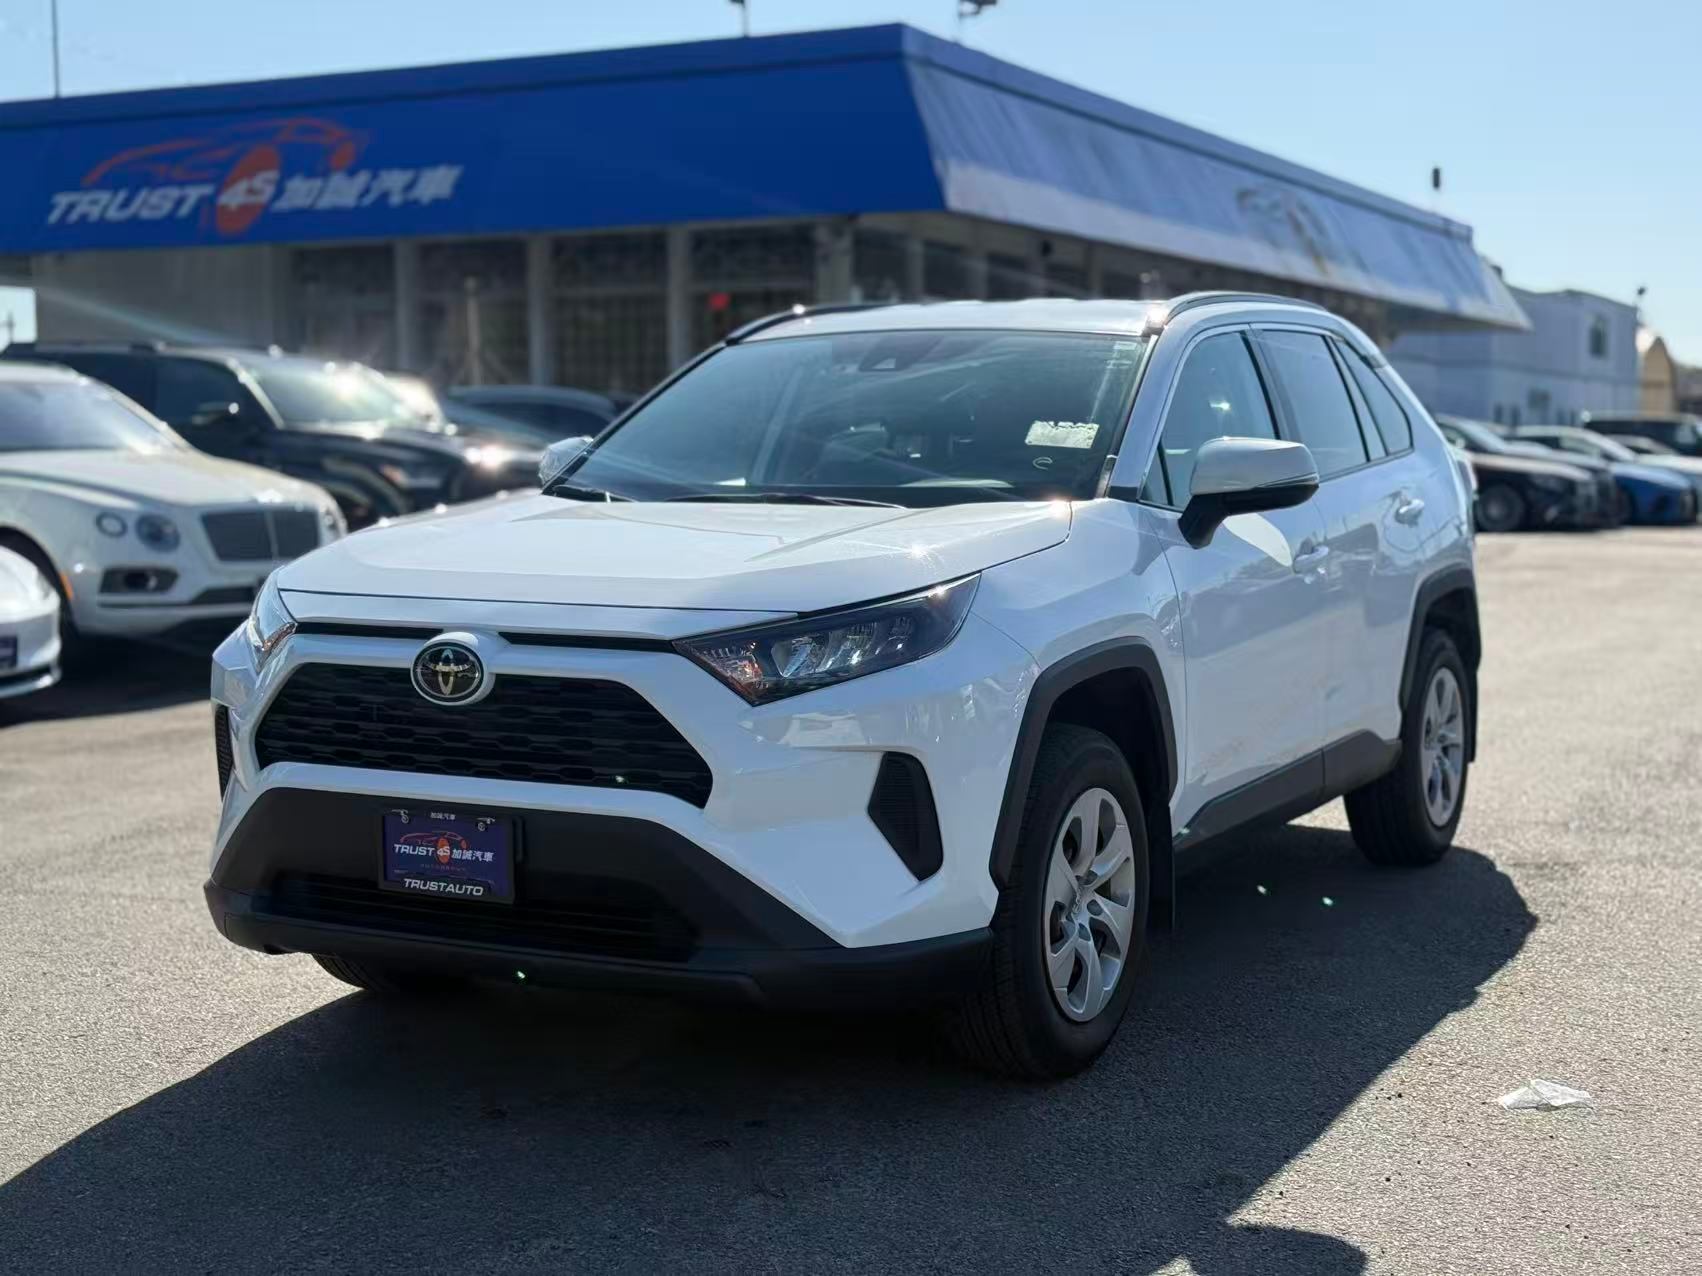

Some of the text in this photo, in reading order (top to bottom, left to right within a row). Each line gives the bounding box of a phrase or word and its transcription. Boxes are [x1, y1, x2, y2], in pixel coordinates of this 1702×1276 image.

[47, 183, 216, 225] TRUST
[216, 169, 280, 210] 4S
[393, 843, 435, 857] TRUST
[436, 846, 450, 856] 4S
[403, 878, 484, 896] TRUSTAUTO
